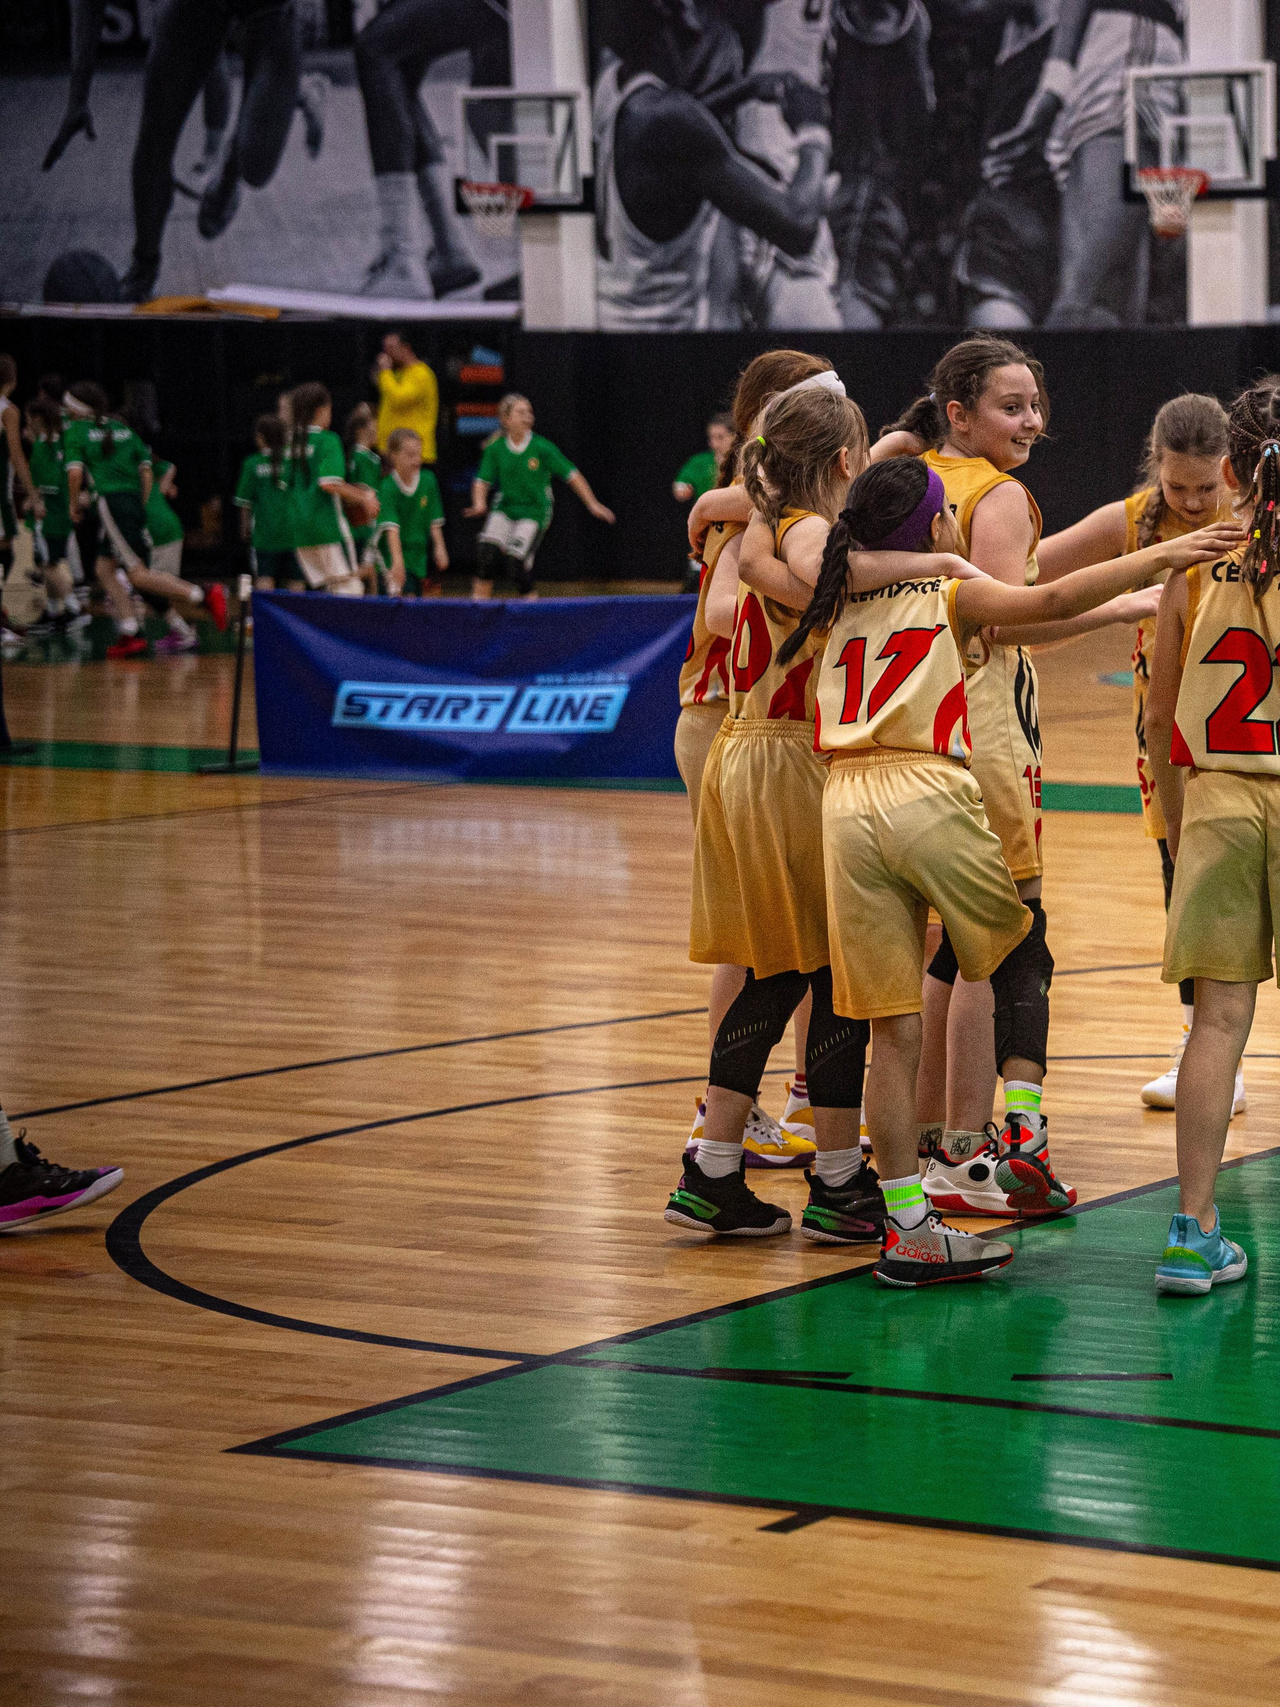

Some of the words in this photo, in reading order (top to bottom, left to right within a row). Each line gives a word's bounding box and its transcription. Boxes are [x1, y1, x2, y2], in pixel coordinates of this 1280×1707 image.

[832, 623, 949, 726] 17
[342, 693, 506, 723] START
[520, 694, 616, 723] LINE
[895, 1244, 946, 1264] adidas
